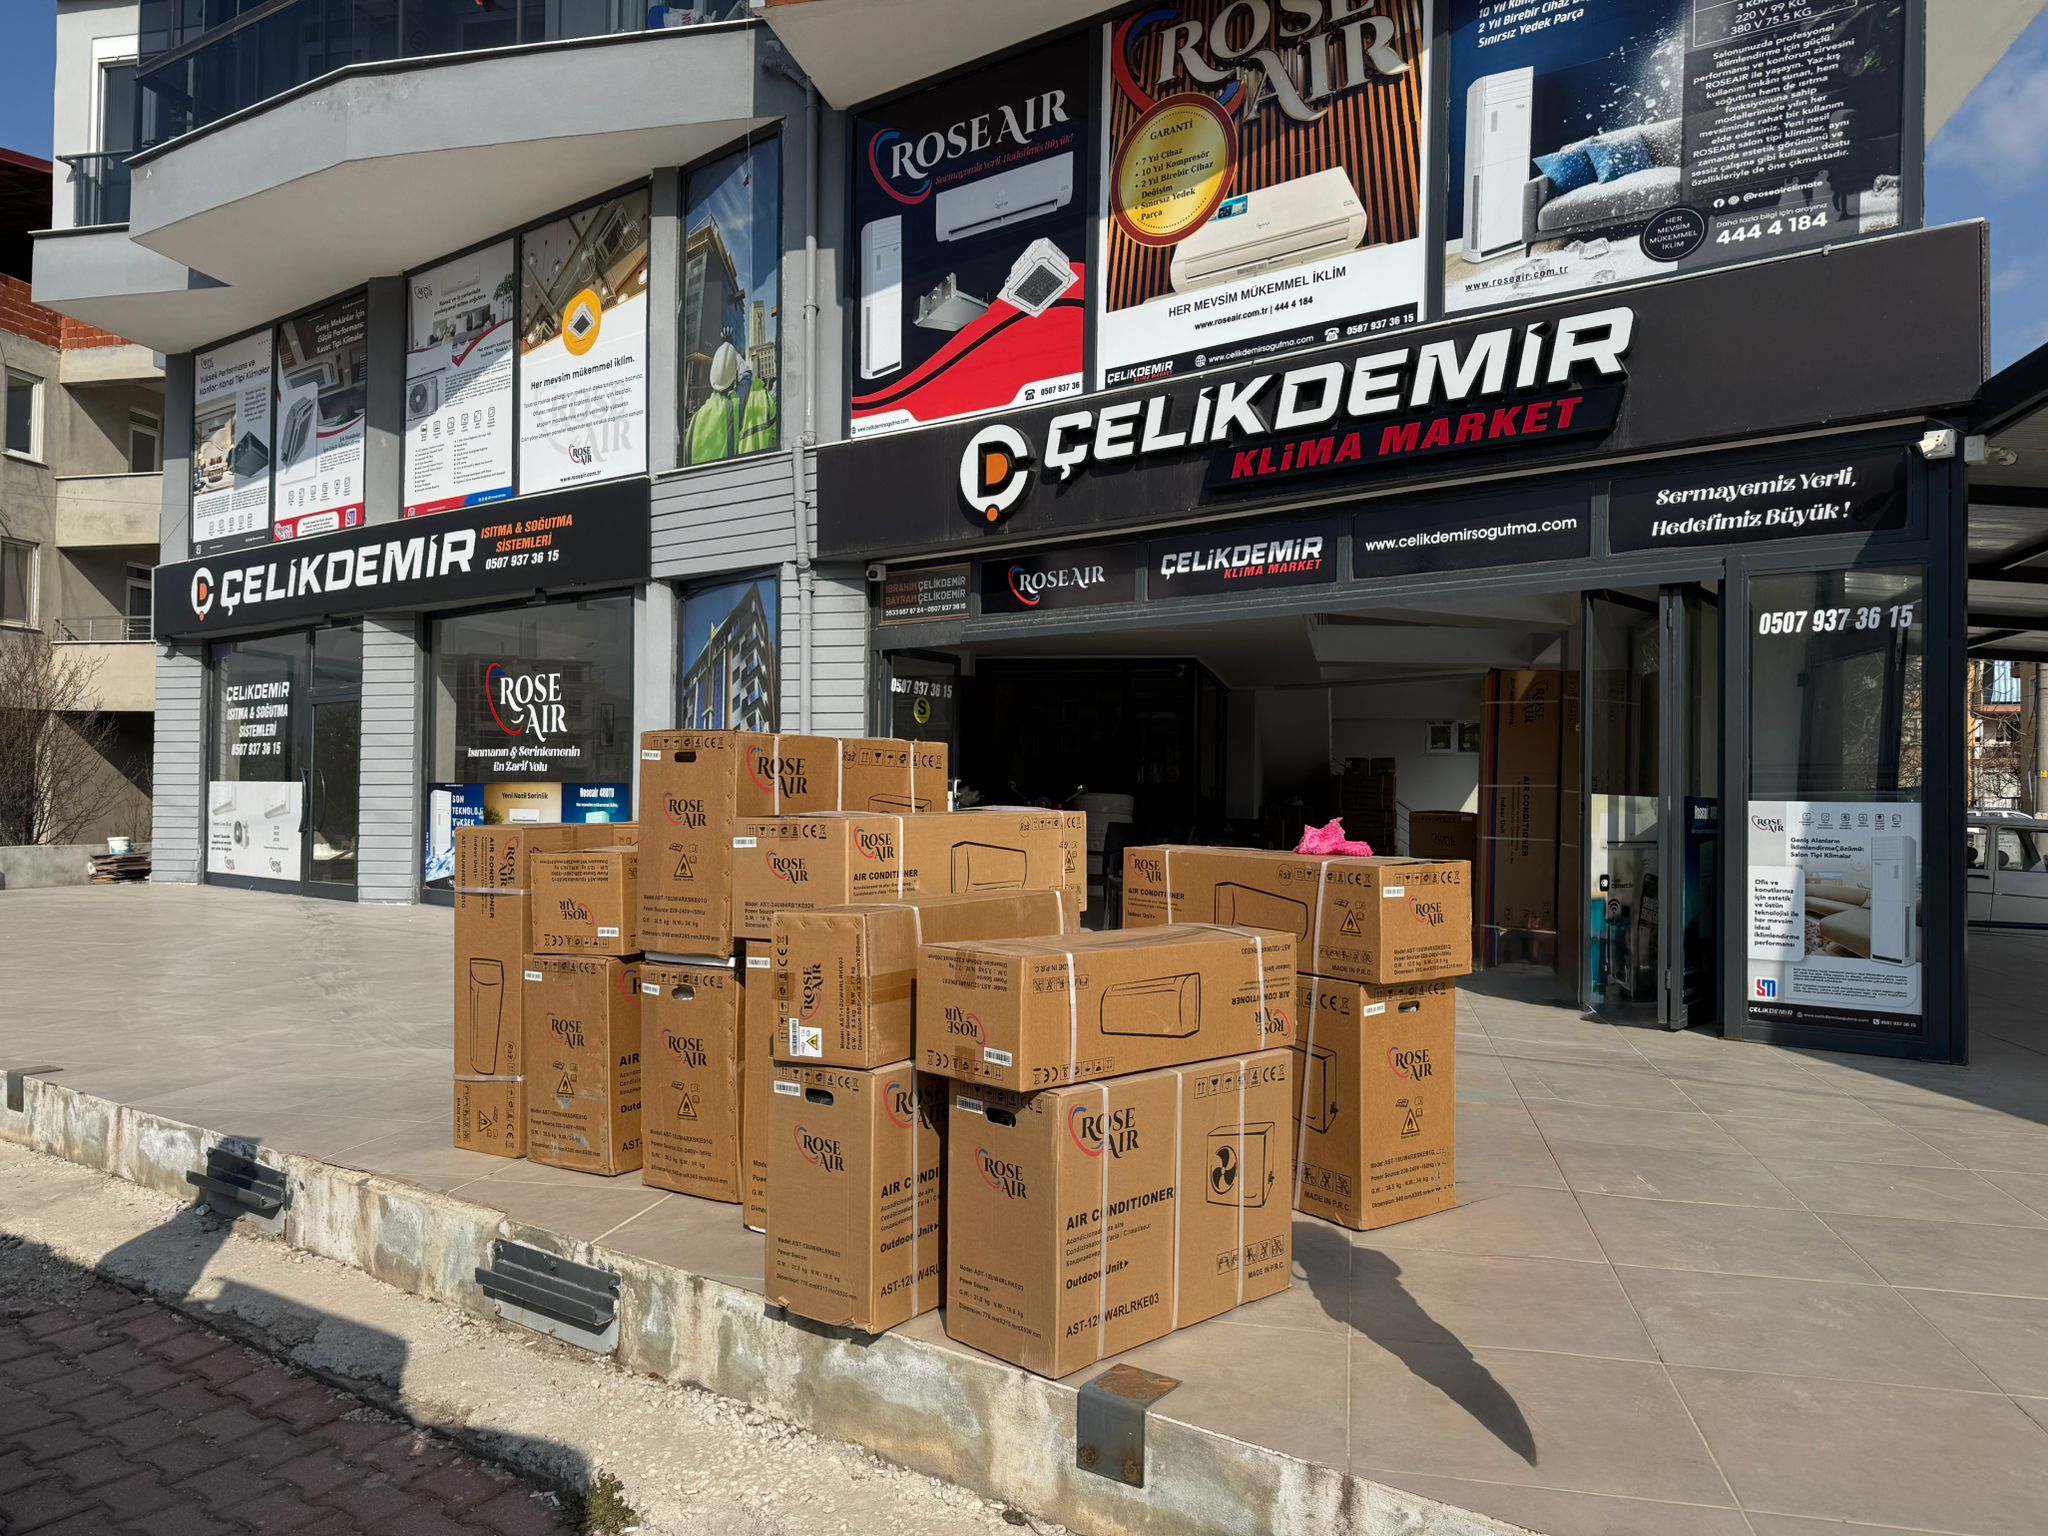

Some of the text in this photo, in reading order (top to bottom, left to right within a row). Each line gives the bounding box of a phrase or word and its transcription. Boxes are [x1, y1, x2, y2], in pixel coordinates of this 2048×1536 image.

[1478, 9, 1538, 33] 2 Birebir
[1731, 8, 1812, 35] 380 V 75.5 KG
[1736, 4, 1785, 23] 220 V 99
[1478, 8, 1584, 48] Sınırsız Yedek Parça
[1776, 23, 1835, 45] profesyonel
[1243, 15, 1411, 121] AIR
[1150, 119, 1193, 140] GARANTİ
[1142, 151, 1210, 176] 10 Yıl Kompresör
[1149, 154, 1159, 163] Yıl
[1161, 148, 1183, 159] Cihaz
[1148, 176, 1159, 186] Yıl
[1161, 167, 1189, 181] Birebir
[1190, 161, 1213, 173] Cihaz
[1172, 188, 1195, 200] Yedek
[1141, 211, 1162, 221] Parça
[1665, 216, 1683, 224] HER
[1716, 210, 1778, 228] Daha bilgi
[1716, 212, 1828, 245] 444 4 184
[1465, 265, 1568, 292] www.roseair.com.tr
[1168, 266, 1347, 318] HER MEVSİM MÜKEMMEL İKLİM
[1194, 296, 1313, 331] www.roseair.com.tr 444 4 184
[1346, 313, 1414, 336] 0507 937 36 15
[530, 355, 635, 390] Her mevsim mükemmel iklim.
[1040, 381, 1080, 396] 0507 937 36
[1044, 306, 1634, 481] ÇELİKDEMİR
[1230, 395, 1583, 481] KLİMA MARKET
[572, 446, 591, 458] ROSE
[1655, 466, 1857, 506] Sermayemiz Yerli,
[480, 514, 573, 542] ISITMA & SOĞUTMA
[1651, 510, 1762, 537] Hedefimiz
[495, 533, 552, 553] SİSTEMLERİ
[1365, 516, 1578, 553] www.celikdemirsogutma.com
[485, 549, 560, 571] 0507 937 36 15
[1160, 536, 1324, 580] ÇELİKDEMİR
[1267, 558, 1323, 574] MARKET
[220, 528, 477, 617] ÇELİKDEMİR
[918, 575, 966, 592] ÇELİKDEMİR
[918, 588, 966, 605] ÇELİKDEMİR
[1759, 604, 1914, 635] 0507 937 36 15
[500, 673, 562, 712] ROSE
[891, 678, 952, 698] 0507 937 36 15
[249, 703, 288, 719] & SOĞUTMA
[525, 704, 568, 742] AIR
[273, 742, 281, 754] 15
[773, 776, 808, 798] AIR
[452, 795, 464, 803] SON
[669, 800, 704, 815] ROSE
[683, 813, 707, 829] AIR
[1757, 818, 1782, 828] ROSE
[1768, 824, 1784, 833] AIR
[860, 833, 892, 848] ROSE
[875, 846, 895, 862] AIR
[499, 863, 508, 887] AIR
[504, 846, 516, 884] ROSE
[773, 858, 806, 874] ROSE
[1134, 859, 1160, 872] ROSE
[787, 869, 808, 884] AIR
[1145, 870, 1162, 883] AIR
[559, 898, 576, 910] AIR
[562, 908, 588, 920] ROSE
[1415, 902, 1442, 916] ROSE
[1427, 913, 1444, 927] AIR
[813, 963, 824, 991] AIR
[1331, 965, 1349, 973] MADE
[803, 966, 814, 1010] ROSE
[944, 1006, 964, 1022] AIR
[551, 1020, 582, 1035] ROSE
[948, 1021, 978, 1038] ROSE
[565, 1032, 584, 1048] AIR
[668, 1035, 704, 1053] ROSE
[619, 1052, 640, 1067] AIR
[683, 1051, 707, 1069] AIR
[1395, 1049, 1430, 1069] ROSE
[1410, 1063, 1433, 1082] AIR
[1081, 1107, 1136, 1142] ROSE
[803, 1134, 841, 1156] ROSE
[1107, 1129, 1140, 1159] AIR
[819, 1152, 845, 1173] AIR
[984, 1157, 1024, 1181] ROSE
[881, 1182, 900, 1198] AIR
[1001, 1177, 1028, 1199] AIR
[1304, 1190, 1332, 1205] MADE IN
[1066, 1213, 1087, 1230] AIR
[1066, 1269, 1101, 1290] Outdoor
